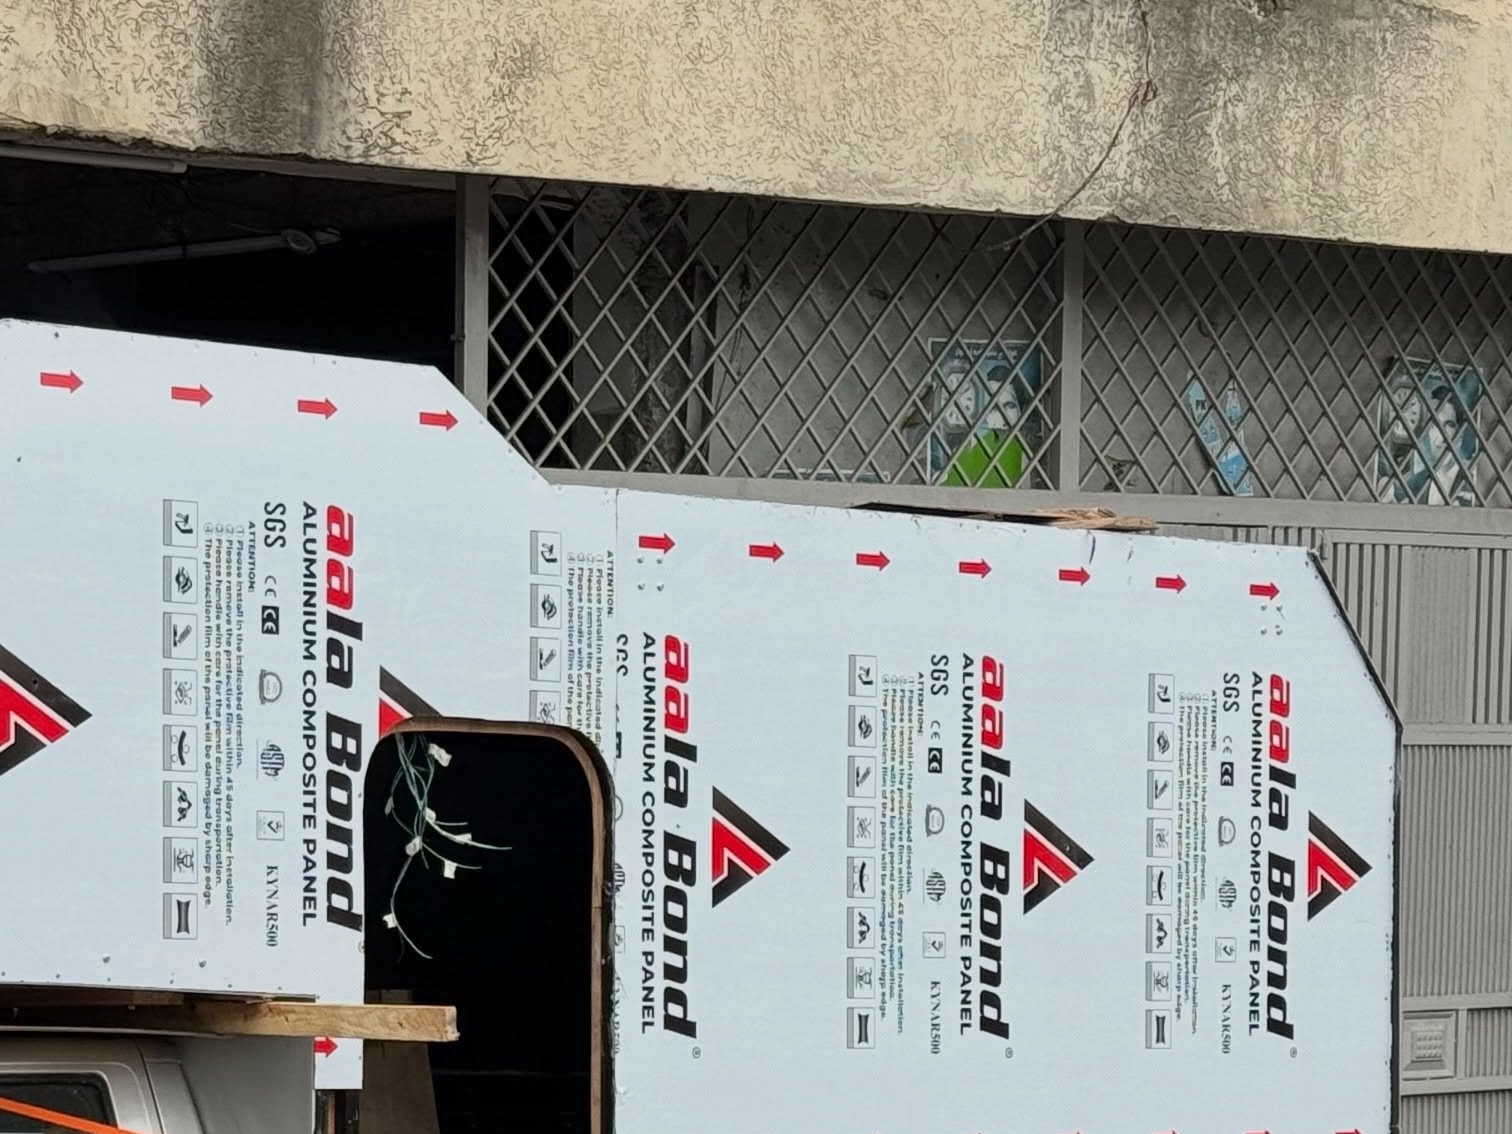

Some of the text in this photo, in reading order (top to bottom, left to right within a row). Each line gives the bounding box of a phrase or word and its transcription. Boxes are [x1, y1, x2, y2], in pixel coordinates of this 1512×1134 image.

[264, 502, 286, 548] SGS
[930, 654, 948, 696] SGS
[1222, 672, 1240, 713] SGS
[302, 500, 316, 928] ALUMINIUM COMPOSITE PANEL
[326, 504, 362, 933] aala Bond
[642, 632, 656, 1034] ALUMINIUM COMPOSITE PANEL
[664, 634, 698, 1040] aala Bond
[960, 652, 975, 1036] ALUMINIUM COMPOSITE PANEL
[980, 655, 1011, 1040] aala Bond
[1248, 670, 1263, 1036] ALUMINIUM COMPOSITE PANEL
[1267, 673, 1296, 1041] aala Bond
[264, 864, 278, 947] KYNAR500
[930, 980, 942, 1054] KYNAR500
[1220, 984, 1232, 1054] KYNAR500
